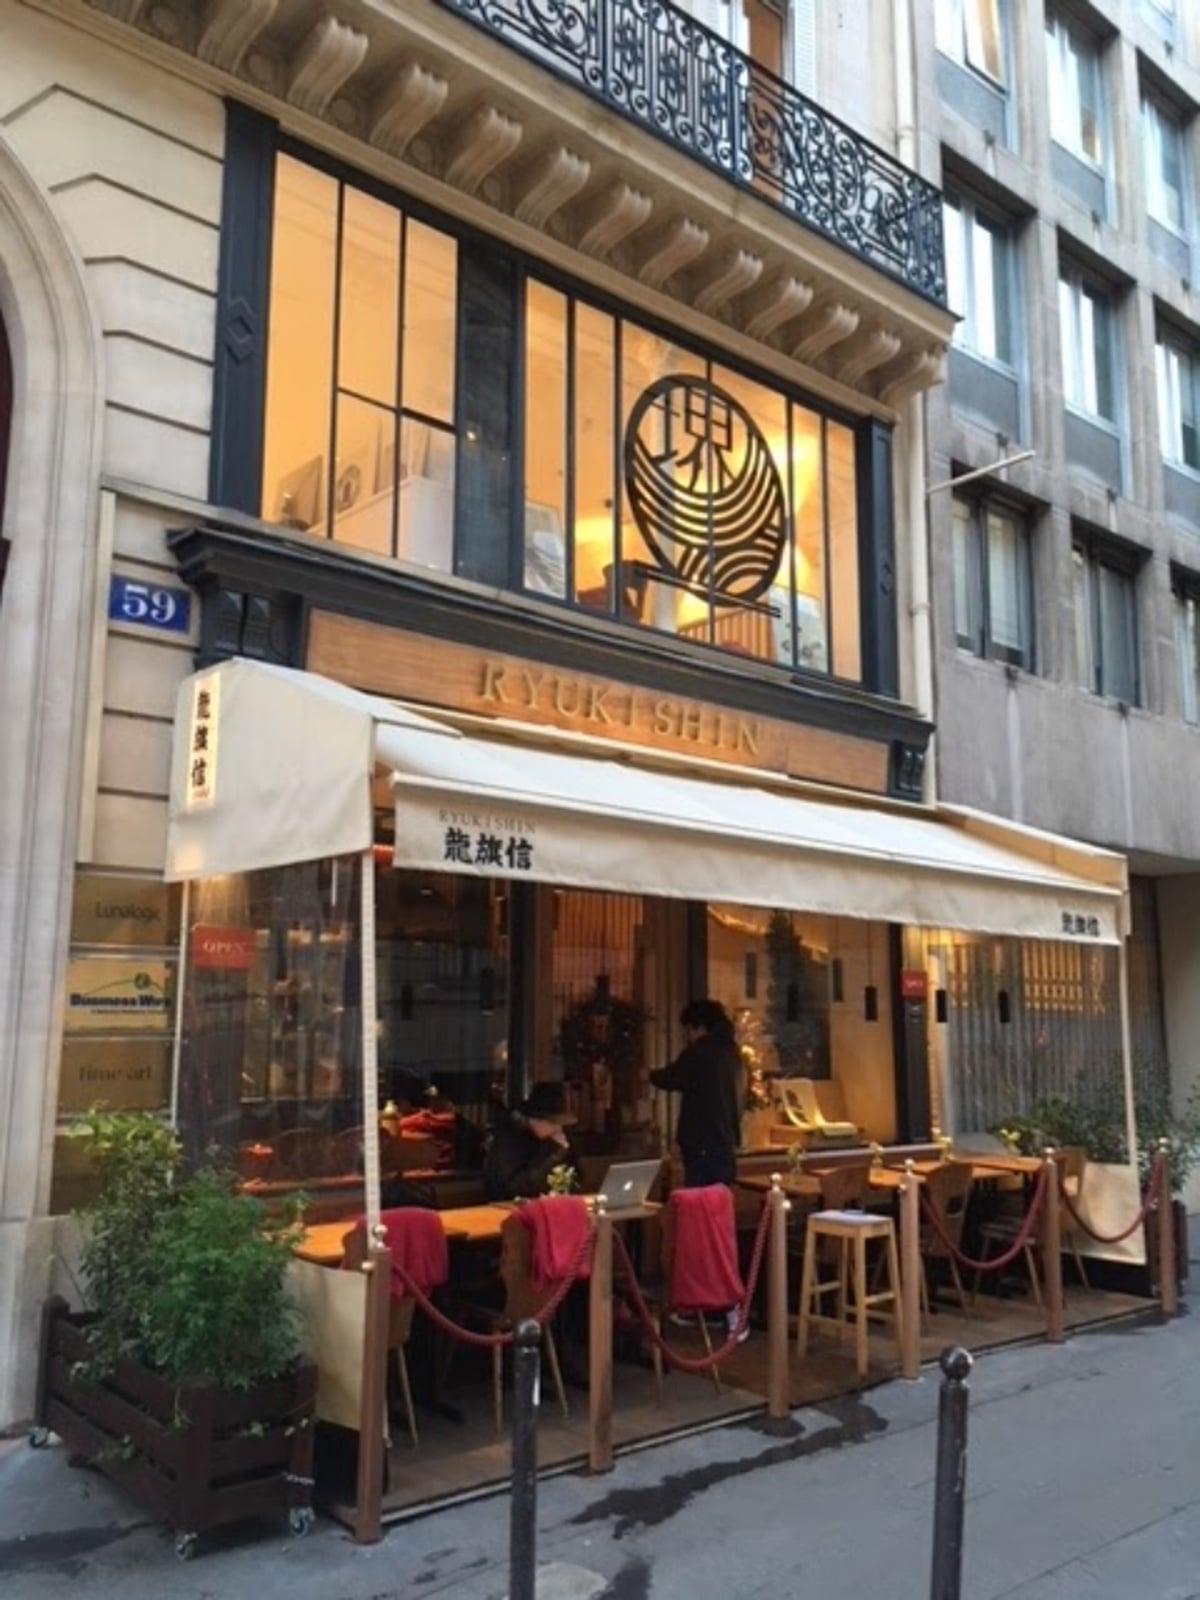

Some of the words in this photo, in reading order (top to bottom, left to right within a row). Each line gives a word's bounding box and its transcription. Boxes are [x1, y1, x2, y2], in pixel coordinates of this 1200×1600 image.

[122, 583, 176, 624] 59
[478, 660, 760, 754] RYUKISHIN
[440, 808, 536, 834] RYUKISHIN
